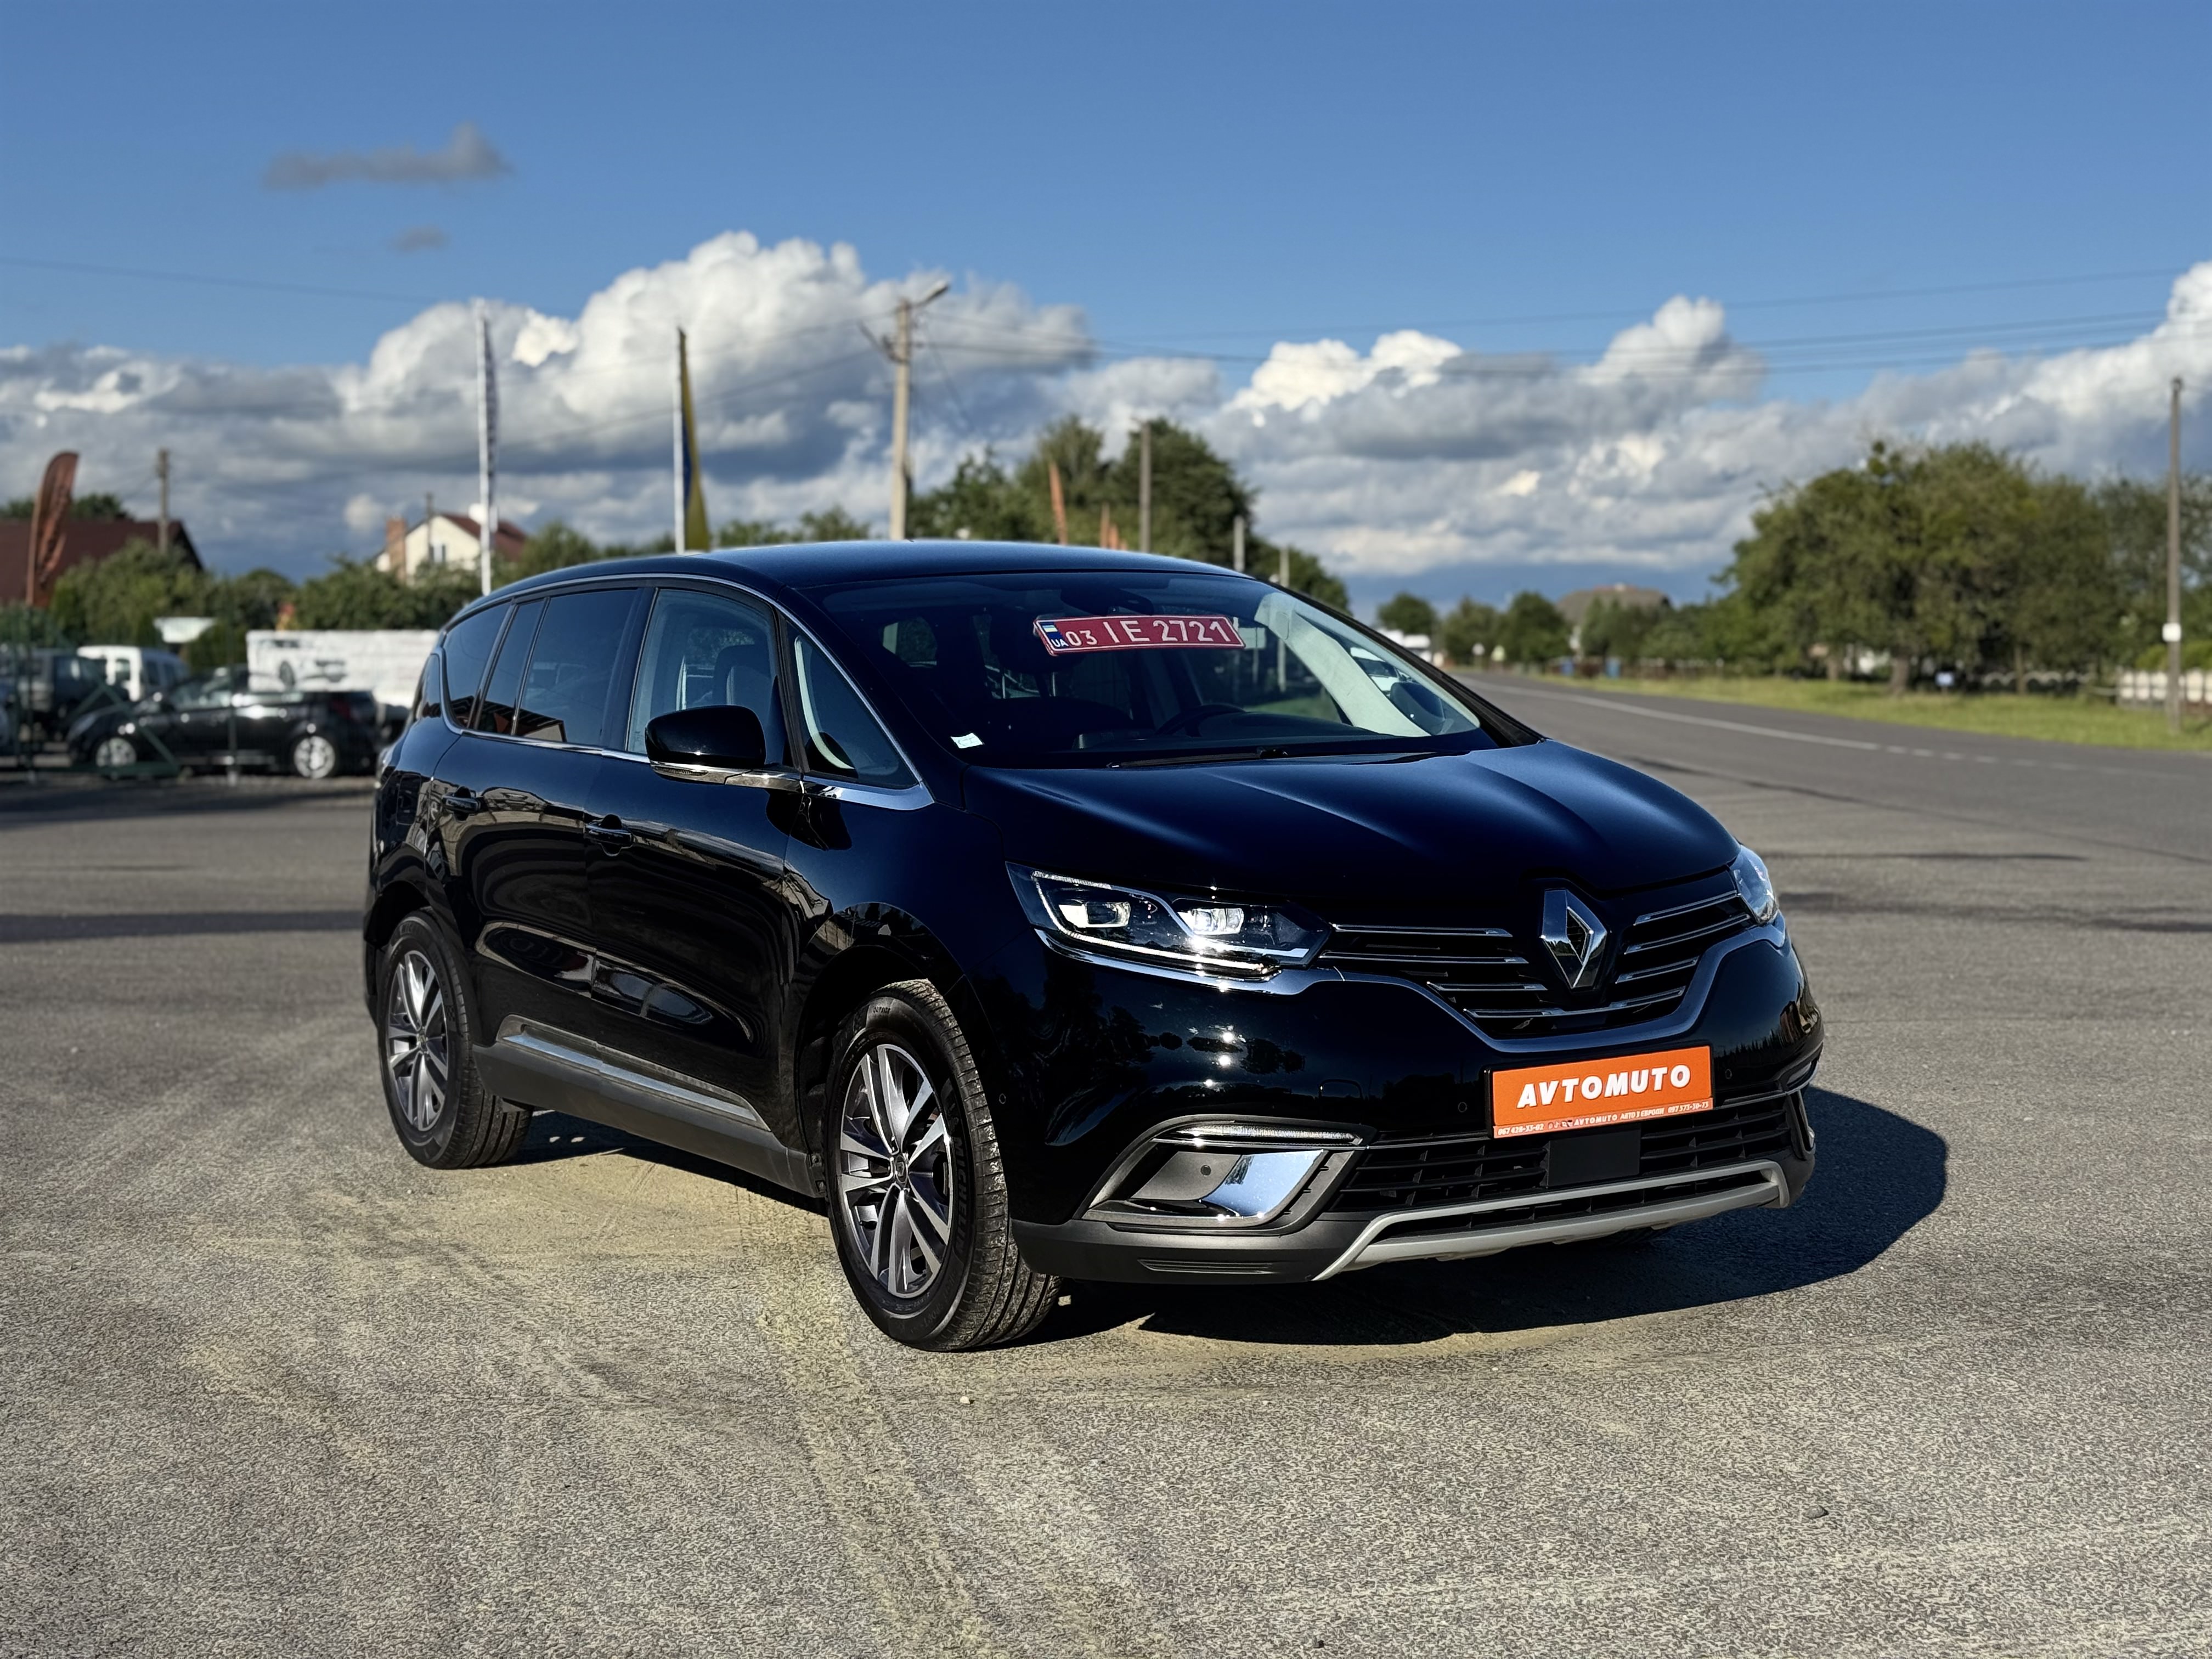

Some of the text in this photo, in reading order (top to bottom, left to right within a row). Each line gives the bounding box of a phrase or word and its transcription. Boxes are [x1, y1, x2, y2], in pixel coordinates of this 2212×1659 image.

[1051, 638, 1069, 648] UA
[1065, 620, 1231, 646] 03 IE 2721
[1516, 1064, 1691, 1109] AVTOMUTO
[1573, 1114, 1618, 1126] AVTOMUTO
[953, 1137, 967, 1255] MICHELIN
